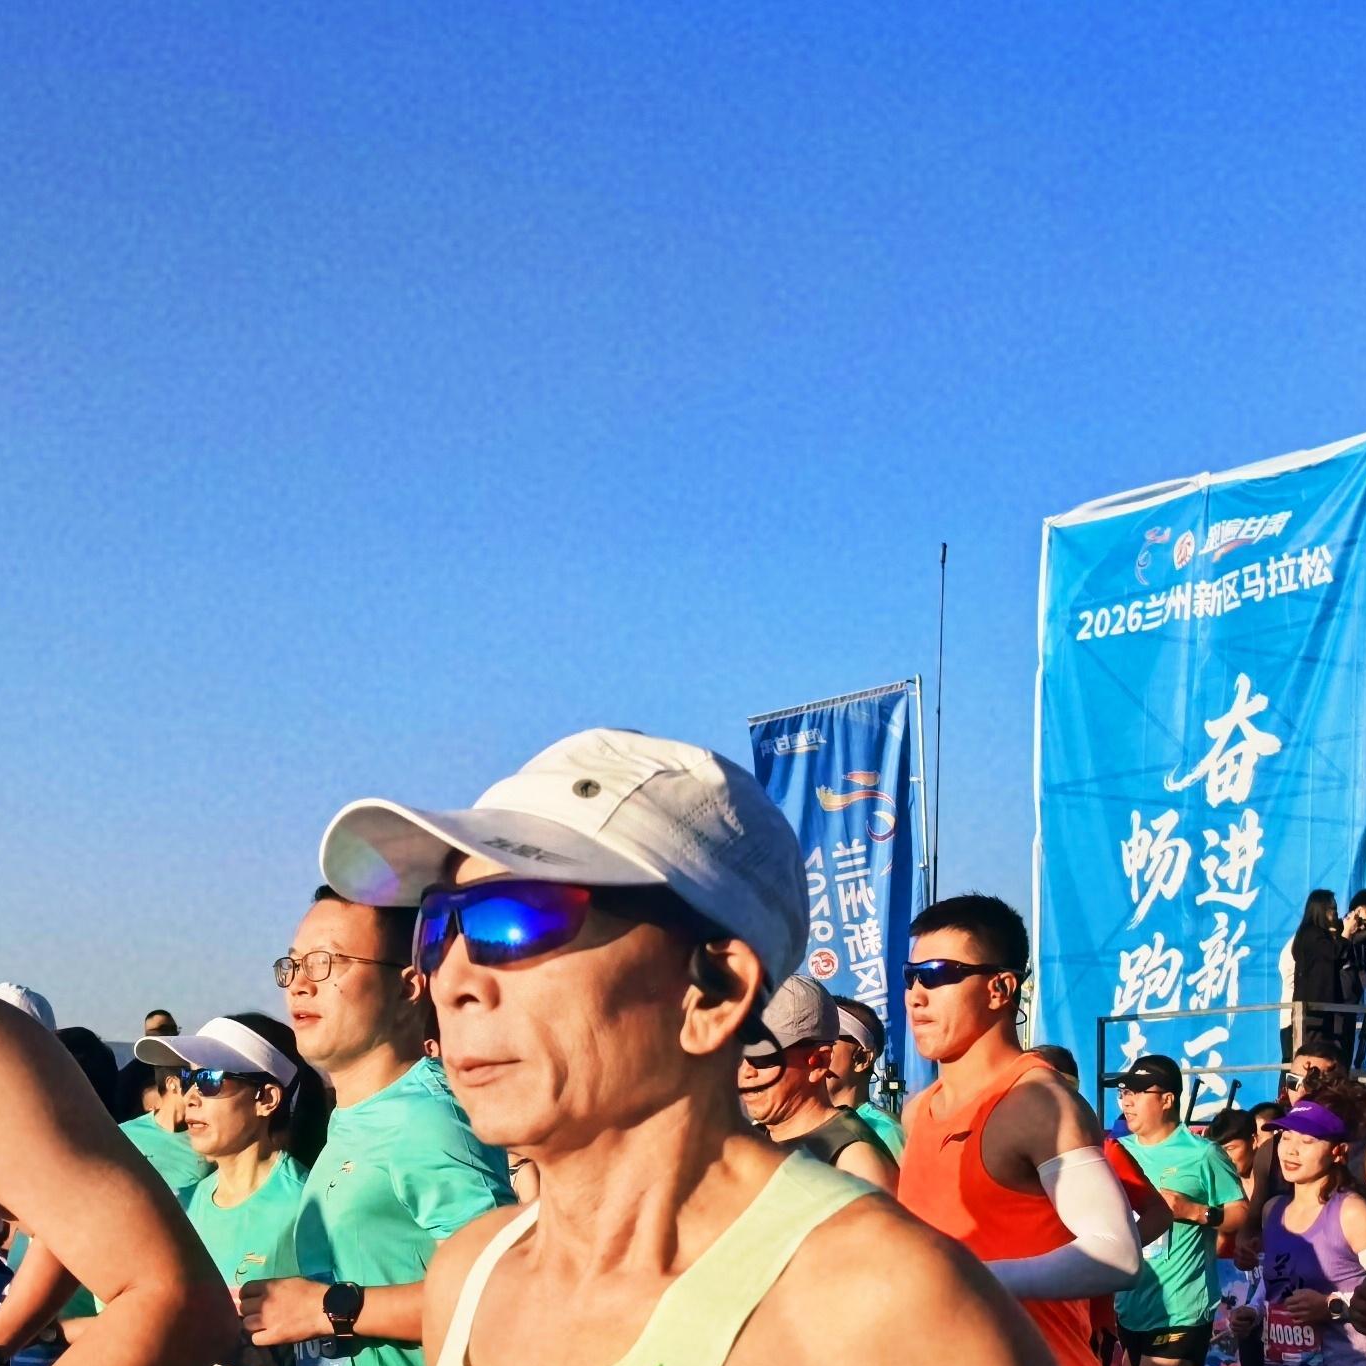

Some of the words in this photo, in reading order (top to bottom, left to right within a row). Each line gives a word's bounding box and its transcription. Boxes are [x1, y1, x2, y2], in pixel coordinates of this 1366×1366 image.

[1076, 544, 1334, 641] 2026兰州新区马拉松
[1164, 672, 1281, 1122] 奋进新区
[1269, 1323, 1315, 1346] 40089
